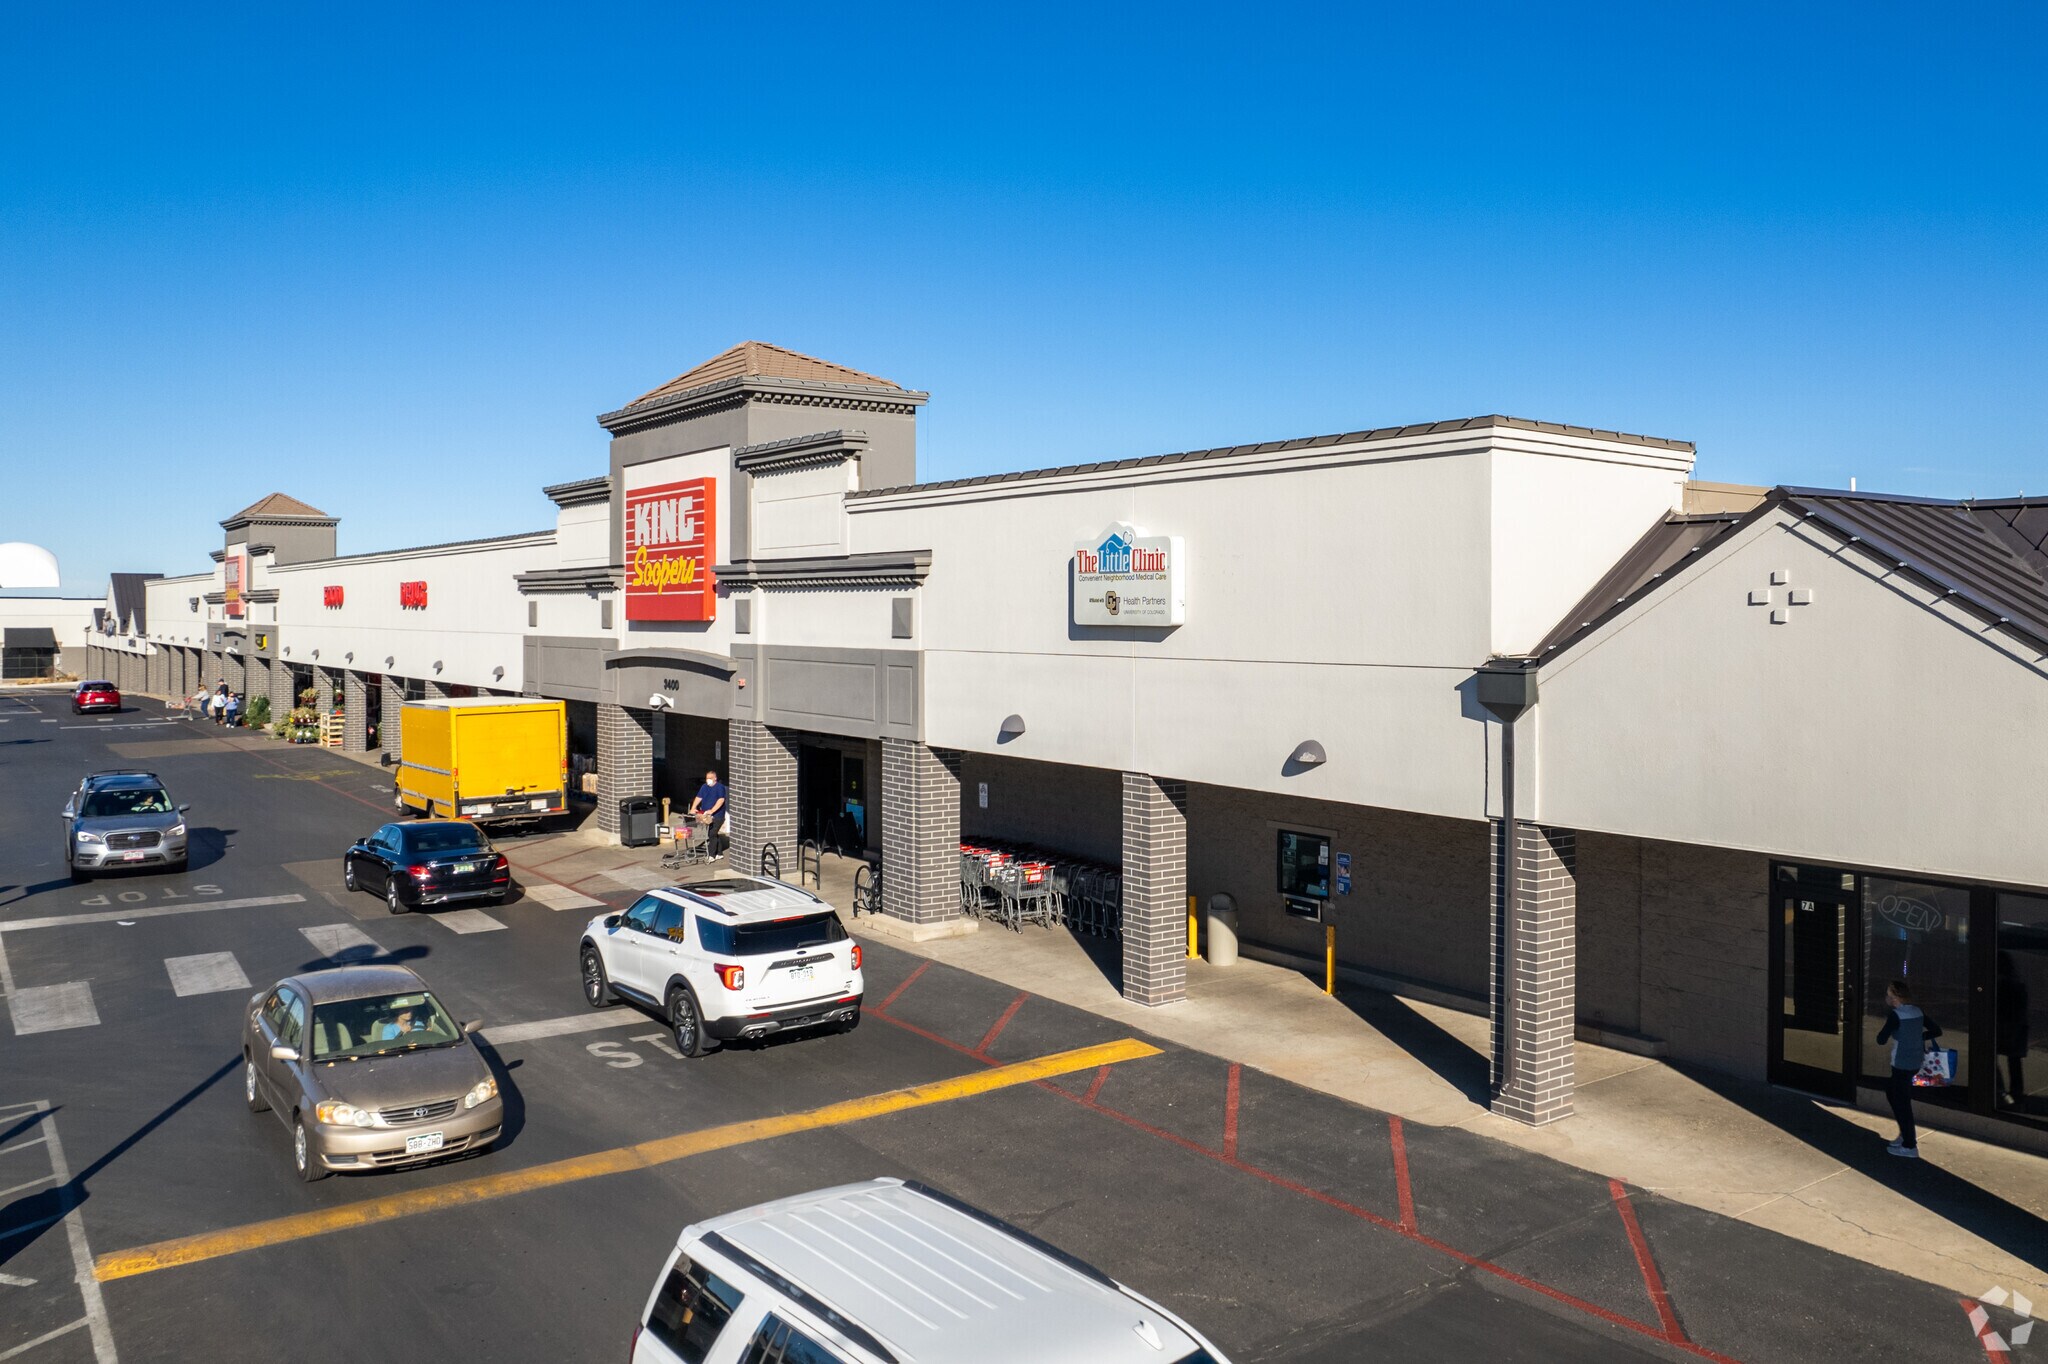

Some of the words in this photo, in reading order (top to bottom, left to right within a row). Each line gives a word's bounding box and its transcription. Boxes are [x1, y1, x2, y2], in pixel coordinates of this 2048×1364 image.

[634, 495, 695, 547] KING
[632, 545, 696, 596] Soopers
[1077, 550, 1098, 573] The
[1099, 549, 1130, 573] Little
[1132, 548, 1166, 572] Clinic
[1078, 574, 1103, 582] Convenient
[1103, 573, 1135, 583] Neighborhood
[1135, 573, 1155, 581] Medical
[1155, 572, 1167, 581] Care
[1123, 597, 1141, 605] Health
[1142, 596, 1166, 606] Partners
[663, 678, 680, 692] 3400
[80, 884, 224, 906] STOP
[1880, 894, 1938, 933] OPEN
[585, 1032, 688, 1069] ST
